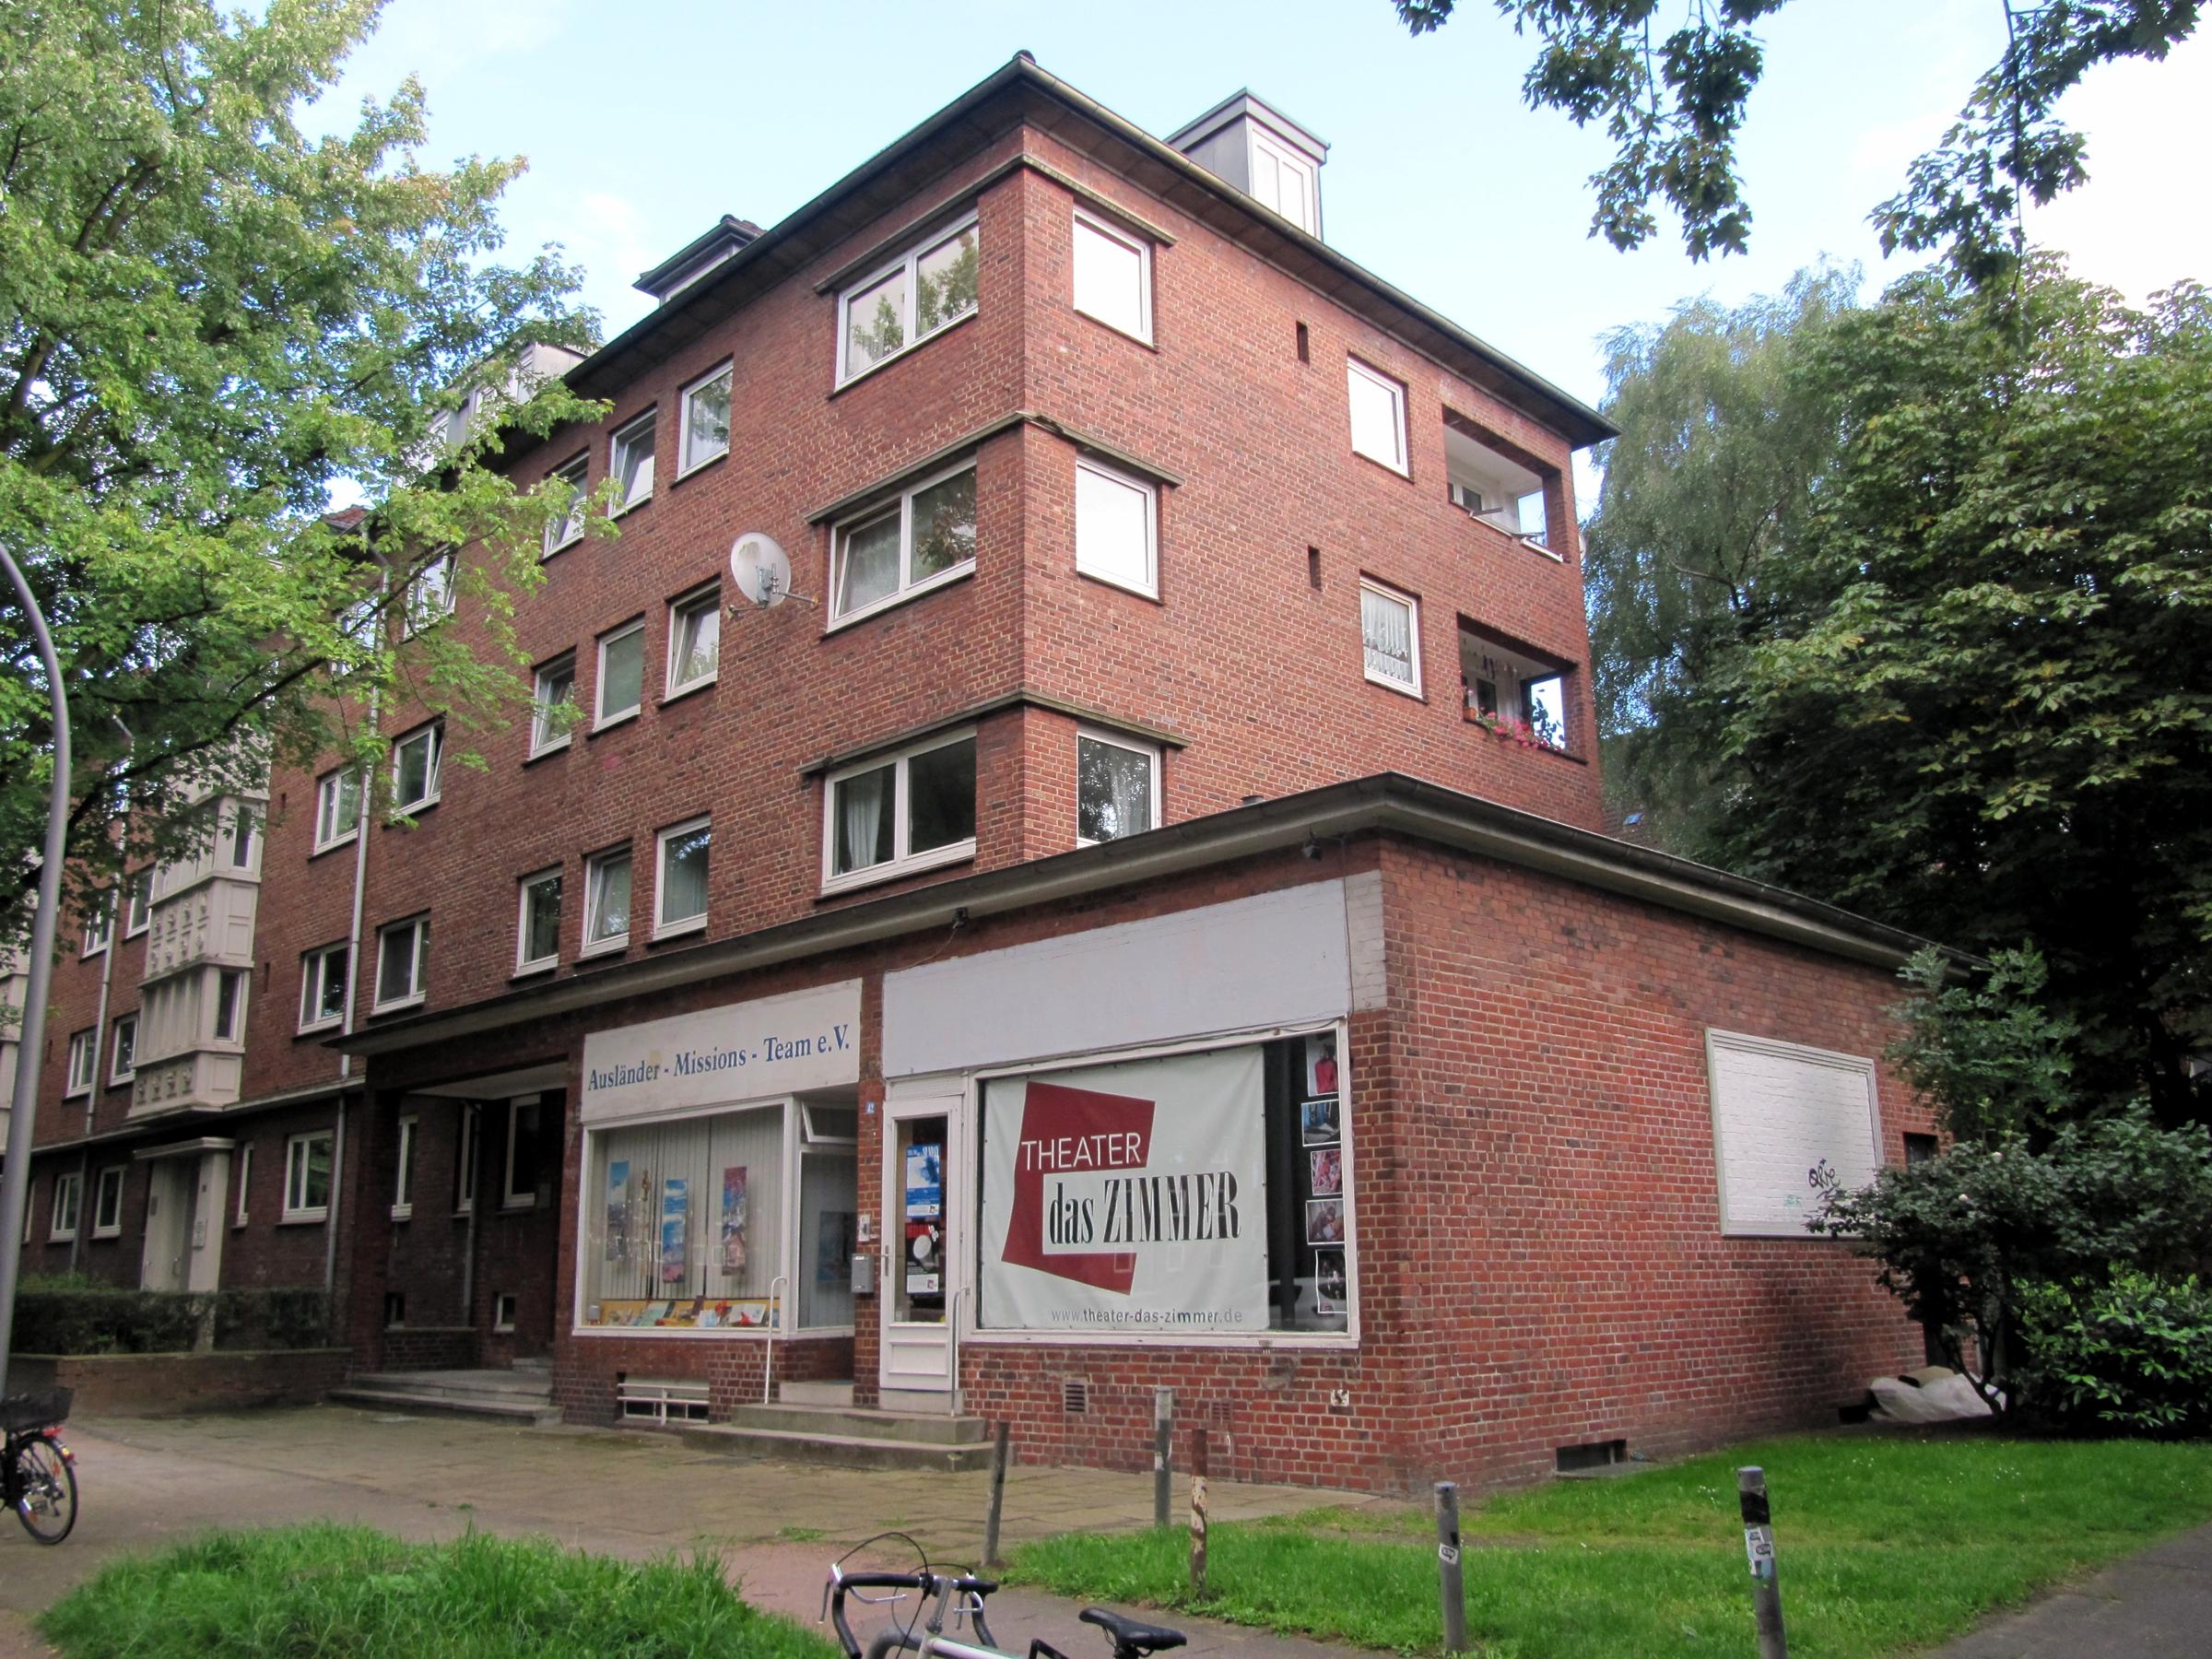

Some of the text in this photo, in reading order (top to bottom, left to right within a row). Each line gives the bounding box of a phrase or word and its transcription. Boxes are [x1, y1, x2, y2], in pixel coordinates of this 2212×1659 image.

[587, 1059, 661, 1091] Ausländer
[674, 1046, 747, 1077] Missions
[763, 1036, 812, 1063] Team
[1020, 1131, 1142, 1171] THEATER
[1049, 1171, 1242, 1245] das ZIMMER
[1051, 1307, 1243, 1324] www.theater-das-zimmer.de
